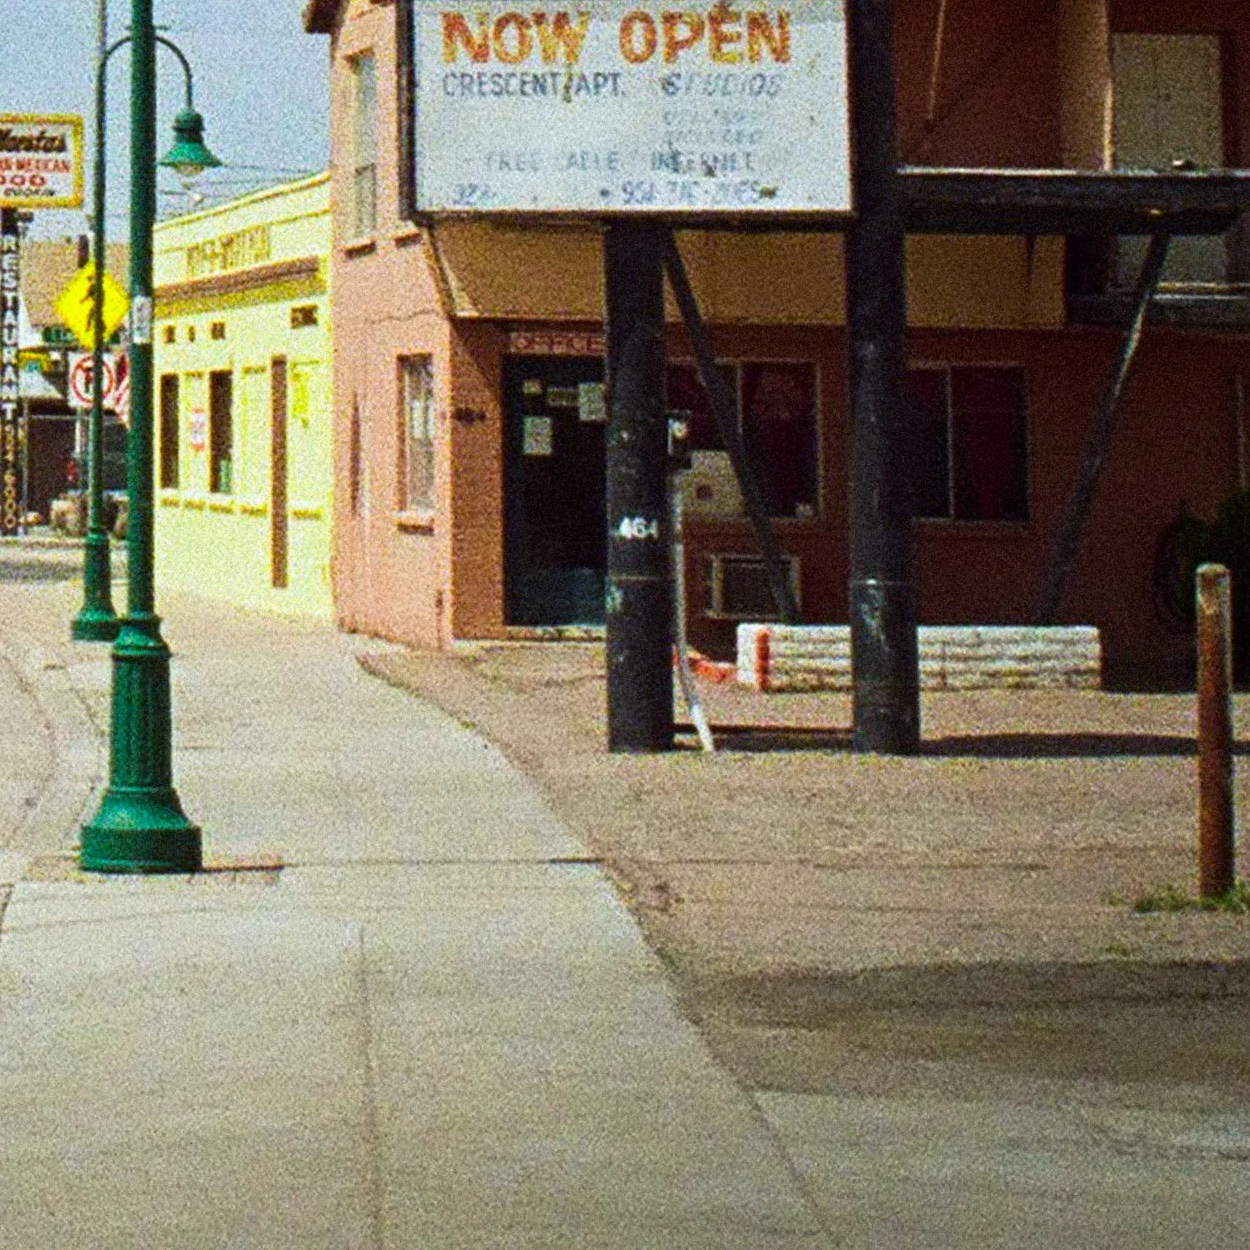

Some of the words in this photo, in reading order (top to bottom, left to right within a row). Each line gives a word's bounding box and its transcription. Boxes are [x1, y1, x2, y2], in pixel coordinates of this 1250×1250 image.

[440, 10, 593, 65] NOW
[618, 6, 792, 65] OPEN
[442, 72, 564, 98] CRESCENT
[513, 332, 606, 355] OFFICE
